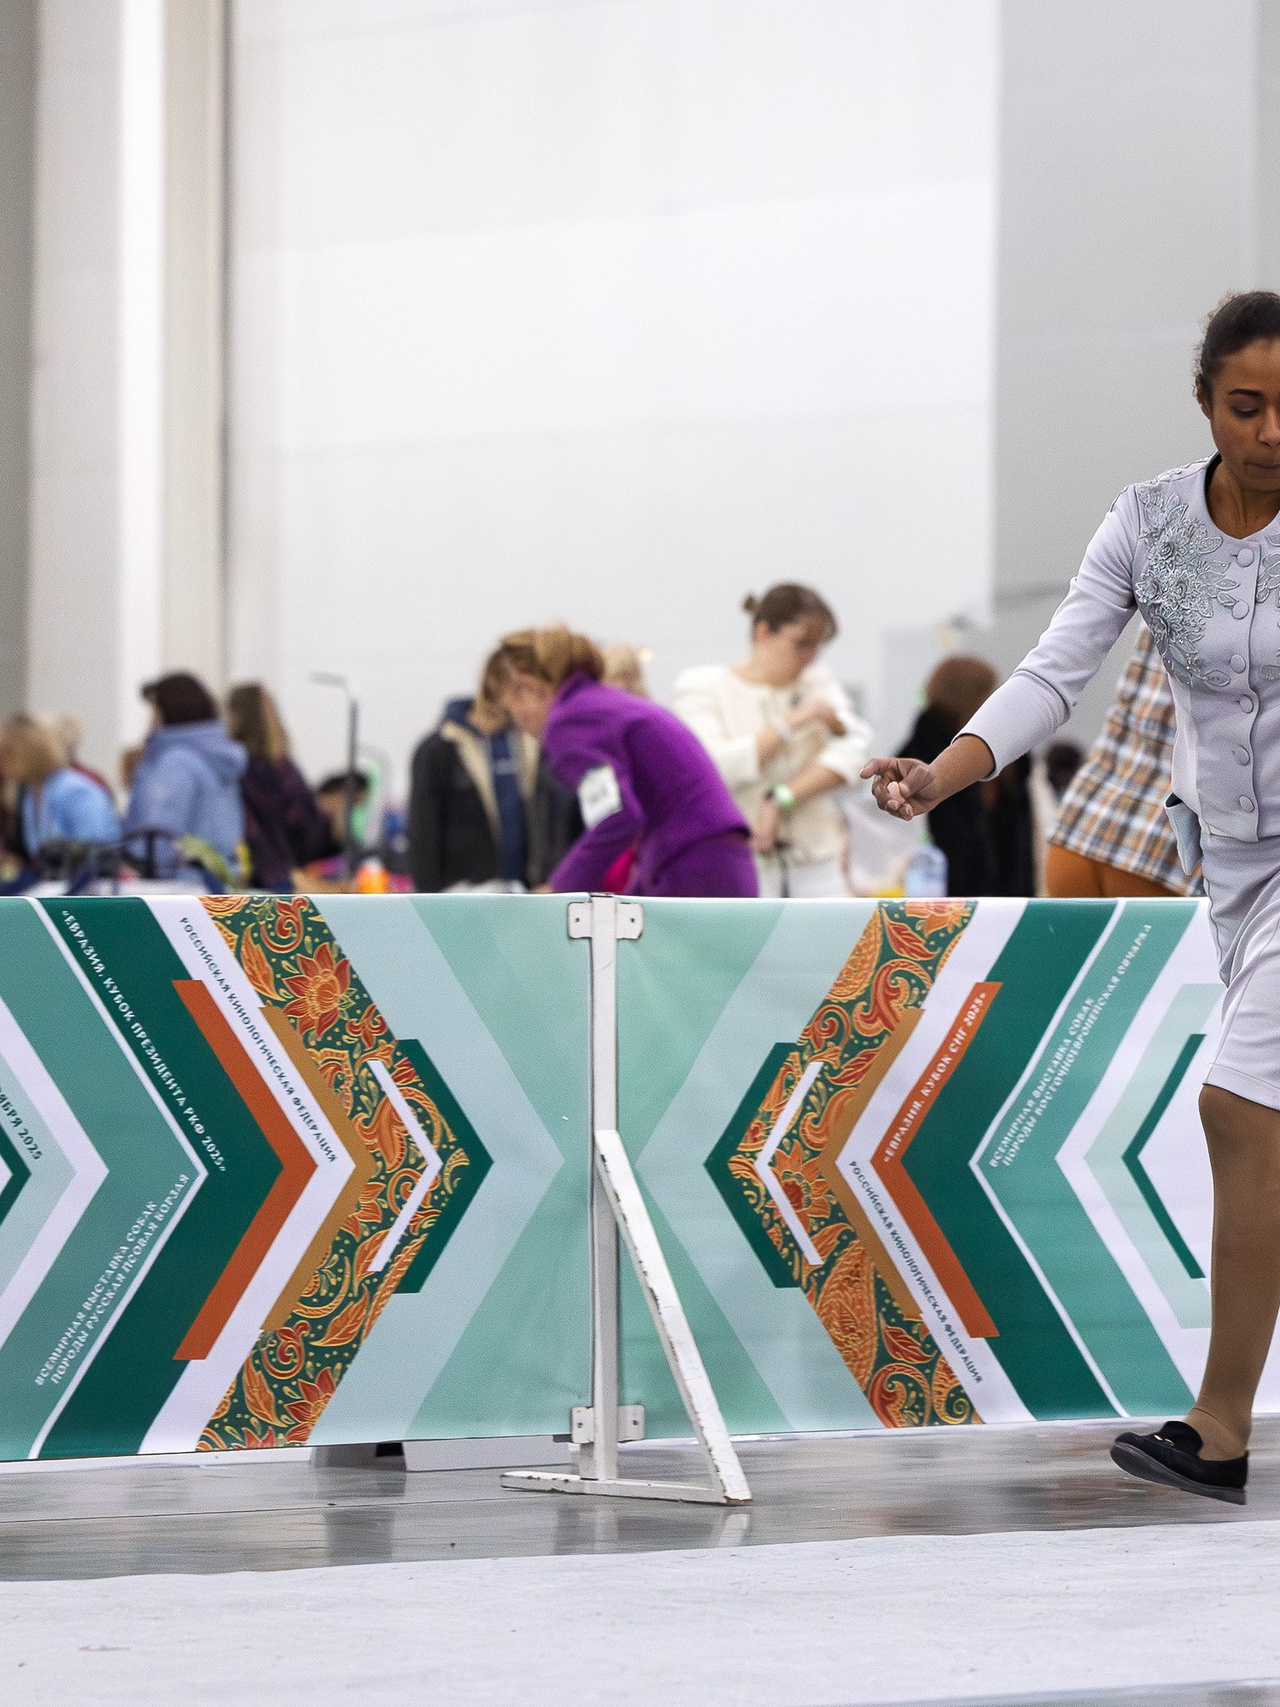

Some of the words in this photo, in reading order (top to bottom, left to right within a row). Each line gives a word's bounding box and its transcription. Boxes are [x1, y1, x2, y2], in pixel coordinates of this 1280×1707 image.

[103, 977, 136, 1022] КУБОК
[131, 1022, 187, 1107] ПРЕЗИДЕНТА
[183, 1107, 205, 1134] РКФ
[179, 917, 231, 993] РОССИЙСКАЯ
[227, 992, 296, 1096] КИНОЛОГИЧЕСКАЯ
[292, 1096, 338, 1163] ФЕДЕРАЦИЯ
[920, 1055, 953, 1097] КУБОК
[949, 1026, 968, 1053] СНГ
[989, 1099, 1036, 1168] ВСЕМИРНАЯ
[1032, 1038, 1072, 1098] ВЫСТАВКА
[1068, 997, 1095, 1036] СОБАК
[1002, 1116, 1037, 1166] ПОРОДЫ
[1117, 924, 1152, 975] ОВЧАРКА
[18, 1129, 43, 1160] 2025
[35, 1311, 86, 1386] ВСЕМИРНАЯ
[82, 1246, 129, 1311] ВЫСТАВКА
[126, 1201, 157, 1242] СОБАК
[51, 1330, 89, 1384] ПОРОДЫ
[85, 1273, 126, 1330] РУССКАЯ
[122, 1222, 159, 1273] ПСОВАЯ
[154, 1174, 190, 1222] БОРЗАЯ
[849, 1160, 894, 1230] РОССИЙСКАЯ
[890, 1229, 947, 1323] КИНОЛОГИЧЕСКАЯ
